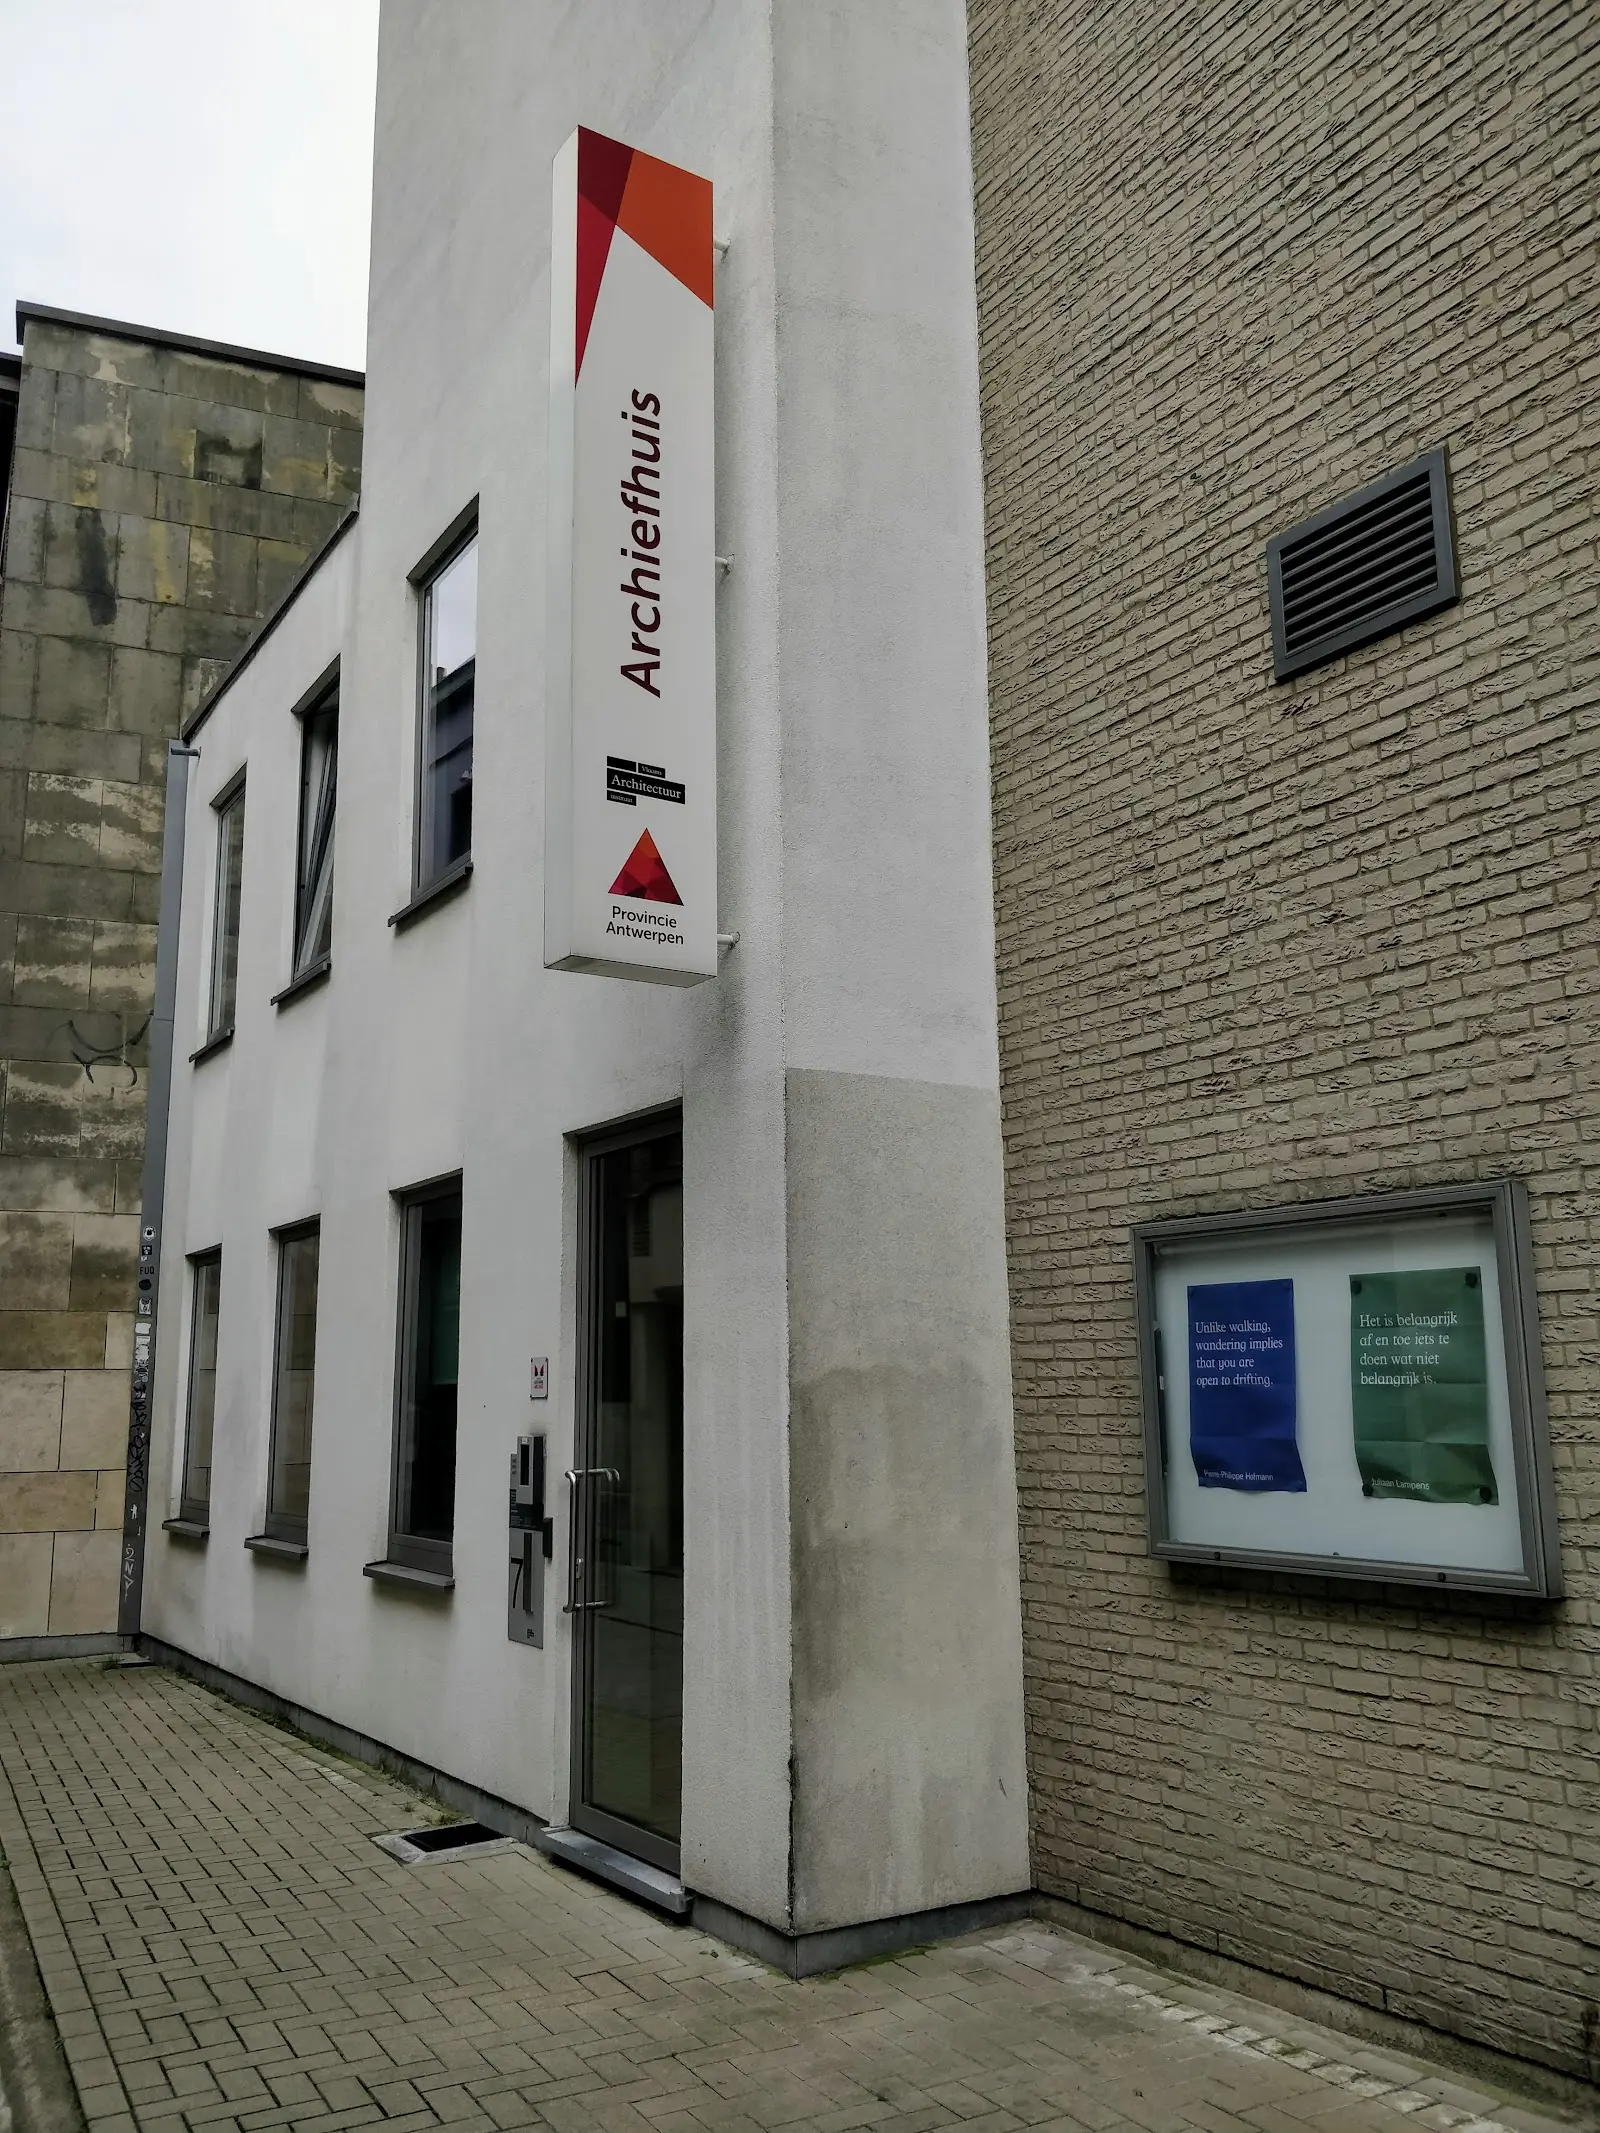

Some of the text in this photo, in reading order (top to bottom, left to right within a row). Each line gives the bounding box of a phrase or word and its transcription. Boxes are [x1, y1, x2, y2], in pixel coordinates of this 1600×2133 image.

[620, 389, 661, 699] Archiefhuis
[611, 775, 682, 799] Architectuur
[612, 905, 677, 928] Provincie
[606, 921, 684, 945] Antwerpen
[1195, 1319, 1271, 1333] Unlike walking,
[1360, 1311, 1458, 1327] Het is belangrijk
[1196, 1337, 1283, 1352] wandering implies
[1360, 1332, 1450, 1346] af en toe iets te
[1196, 1357, 1254, 1370] that you are
[1360, 1351, 1440, 1365] doen wat niet
[1197, 1373, 1273, 1388] open to drifting.
[1361, 1372, 1437, 1387] belangrijk is.
[1396, 1480, 1430, 1490] Lampens
